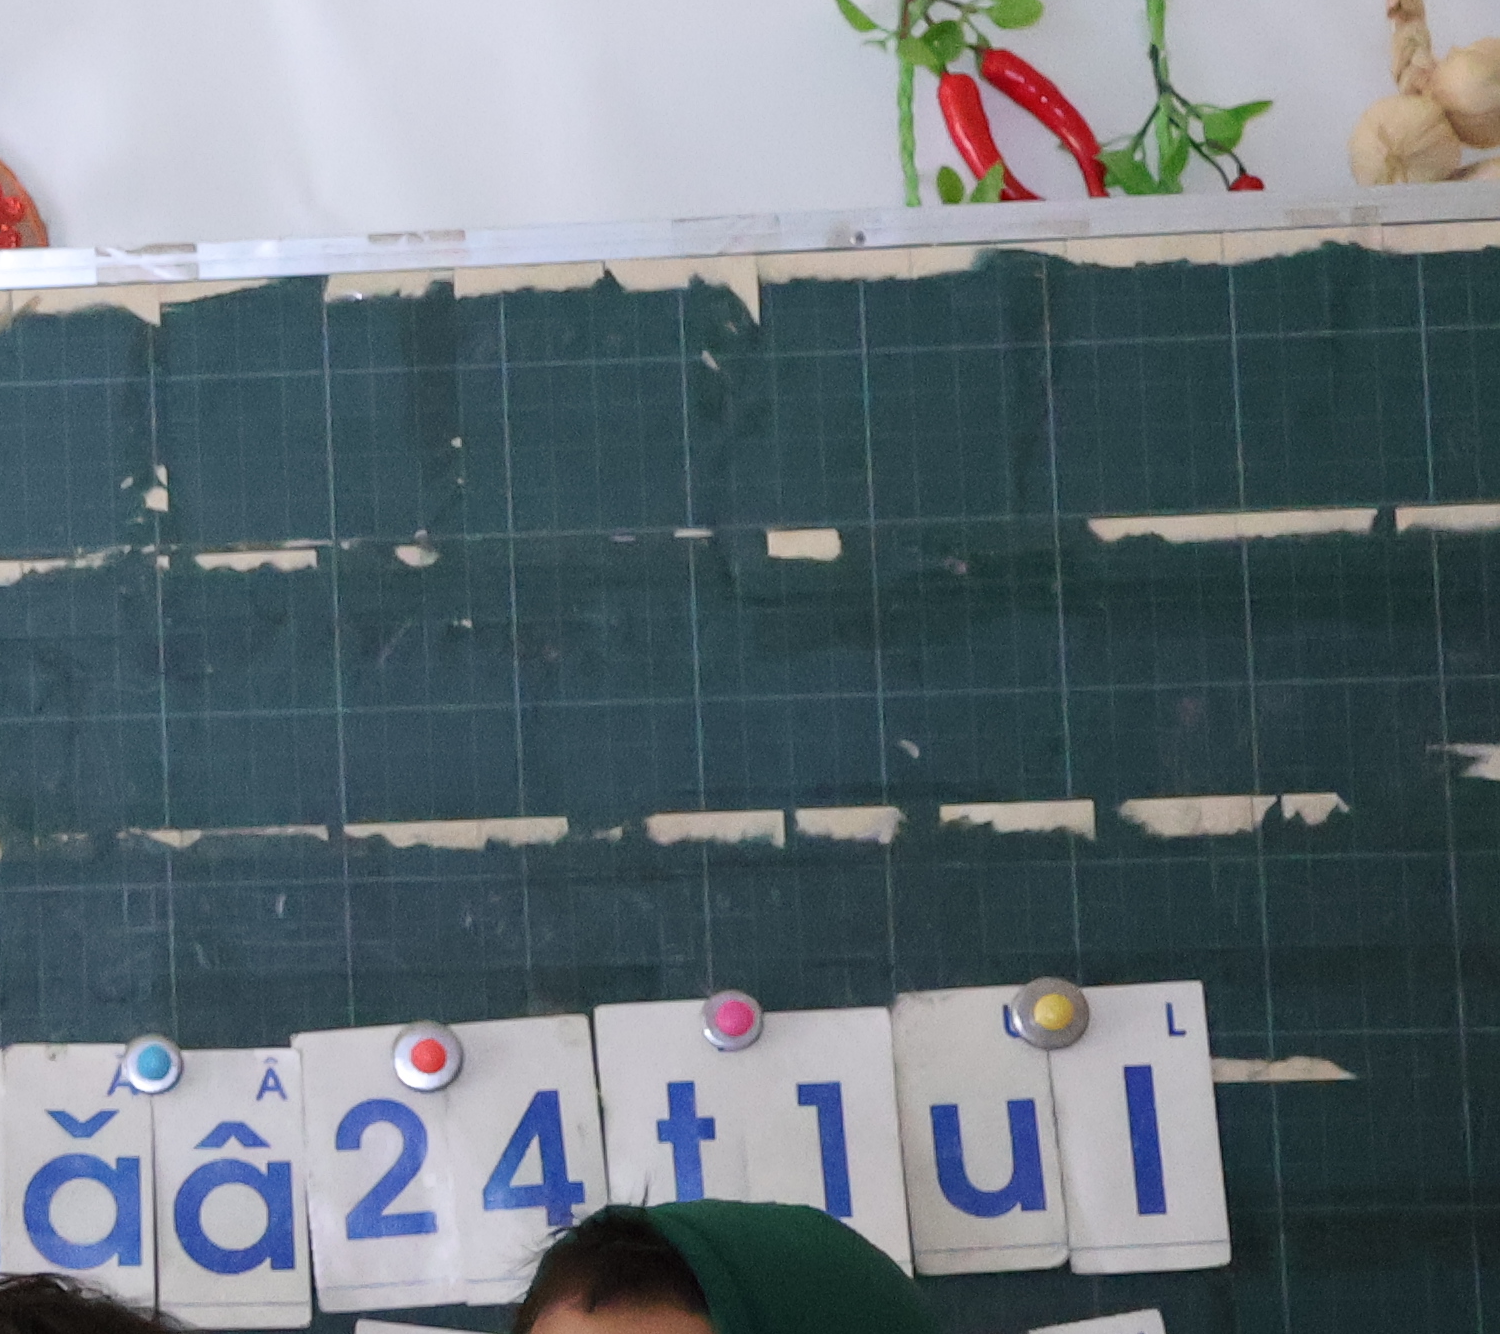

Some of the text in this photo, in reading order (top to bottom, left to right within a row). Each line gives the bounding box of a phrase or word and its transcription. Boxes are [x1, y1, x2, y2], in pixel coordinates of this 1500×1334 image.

[1166, 1002, 1186, 1036] L
[256, 1057, 287, 1101] Â
[23, 1109, 141, 1269] ă
[173, 1121, 295, 1275] â
[335, 1099, 438, 1240] 2
[483, 1090, 584, 1226] 4
[657, 1081, 715, 1203] t
[797, 1081, 852, 1218] 1
[930, 1099, 1046, 1218] u
